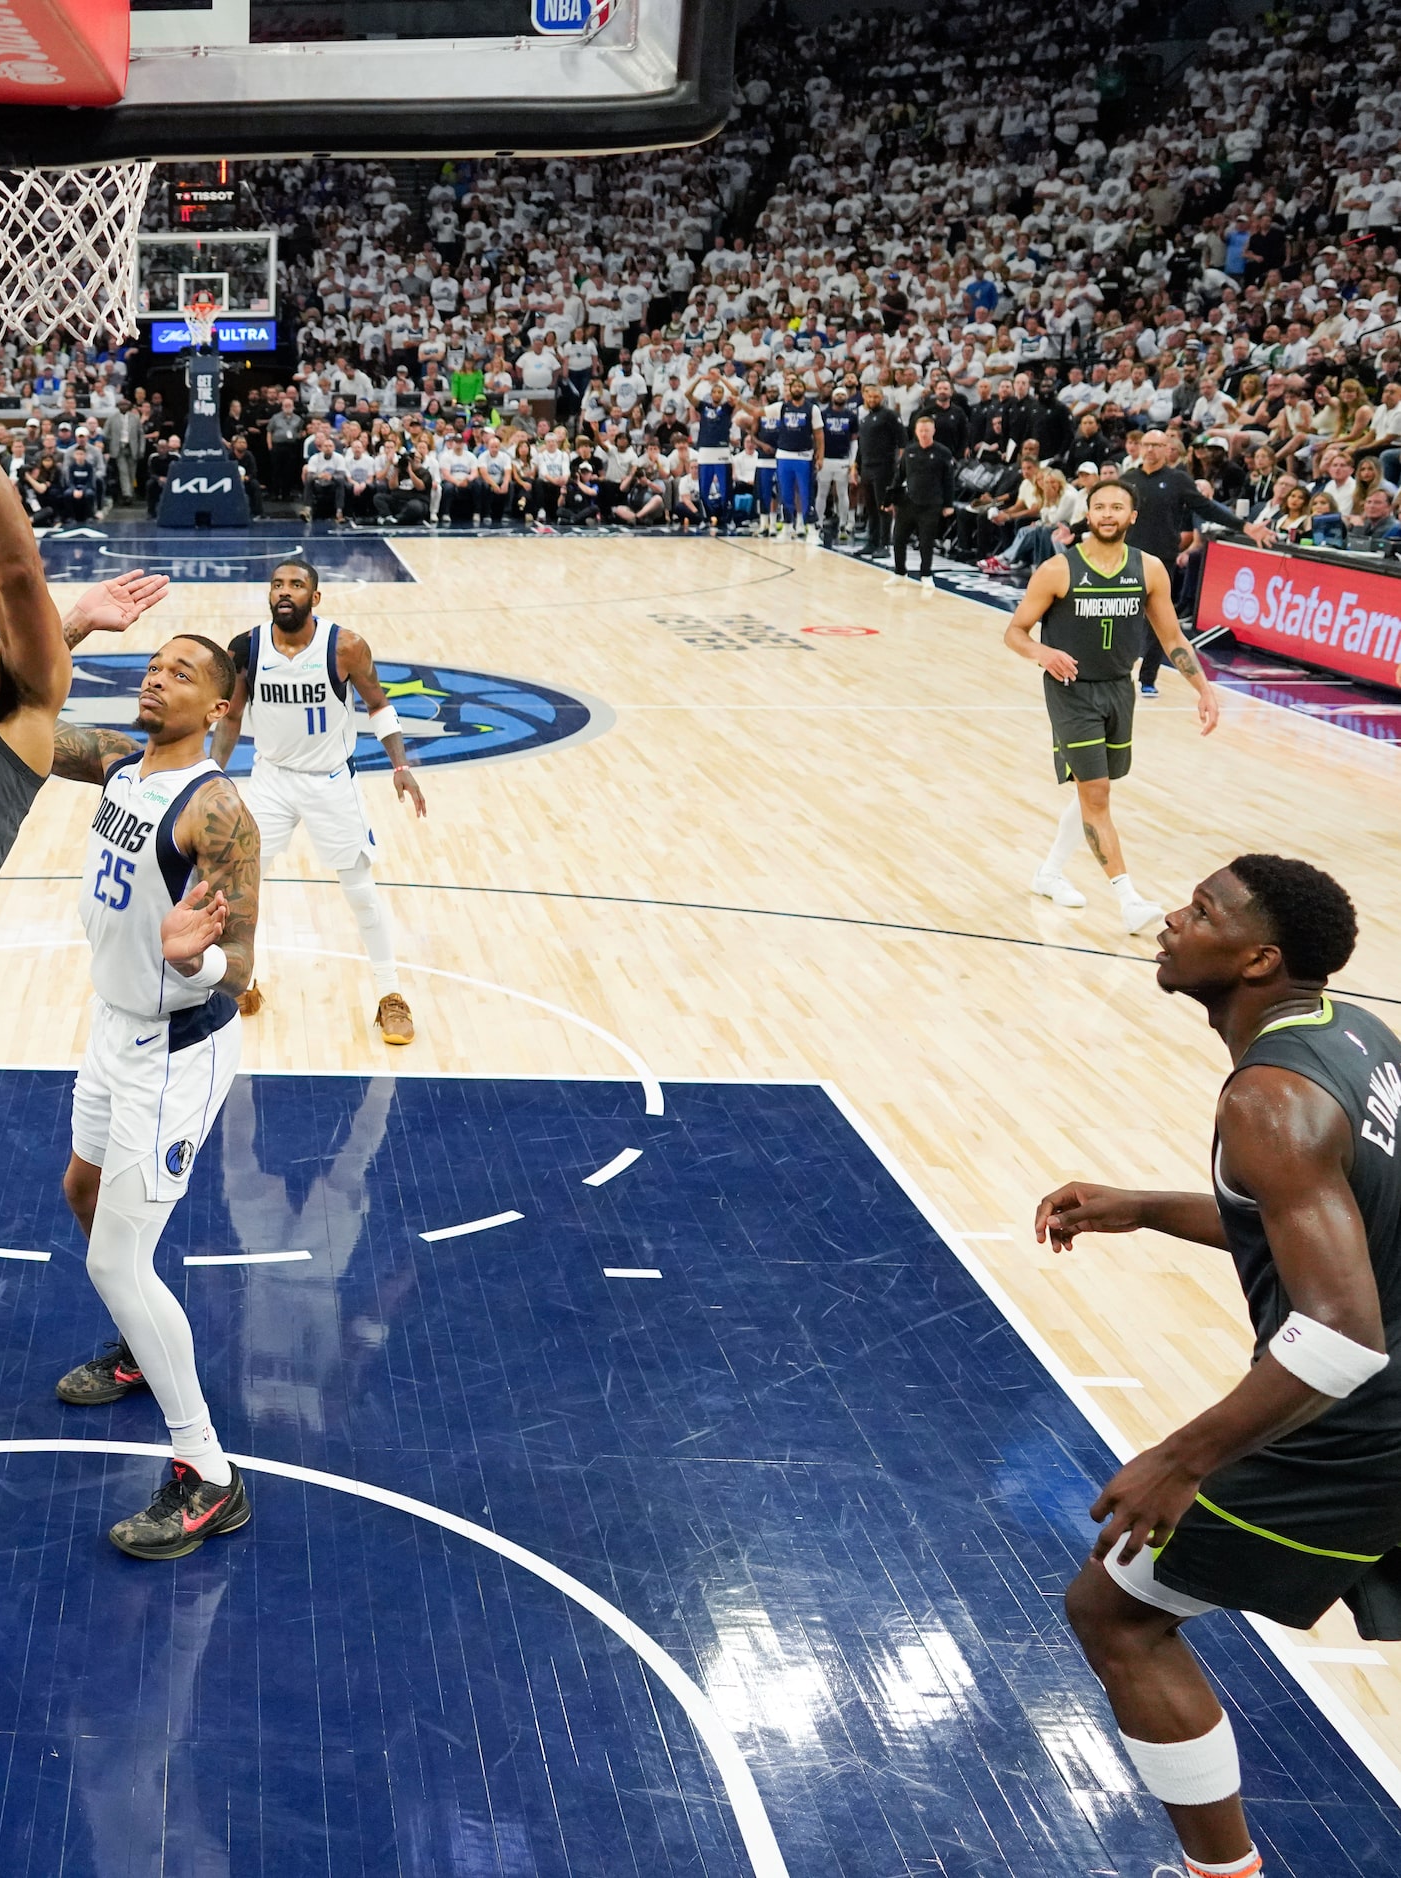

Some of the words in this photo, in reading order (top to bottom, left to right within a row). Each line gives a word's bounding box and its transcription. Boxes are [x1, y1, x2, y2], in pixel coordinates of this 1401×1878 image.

[544, 0, 582, 21] NBA
[192, 191, 235, 201] TISSOT
[219, 327, 269, 341] ULTRA
[171, 477, 233, 493] KIA
[1074, 597, 1141, 619] TIMBERWOLVES
[1101, 618, 1113, 650] 1
[260, 682, 327, 704] DALLAS
[304, 706, 327, 735] 11
[142, 790, 170, 806] chime
[92, 797, 155, 853] DALLAS
[94, 848, 136, 911] 25
[1283, 1327, 1302, 1343] 5
